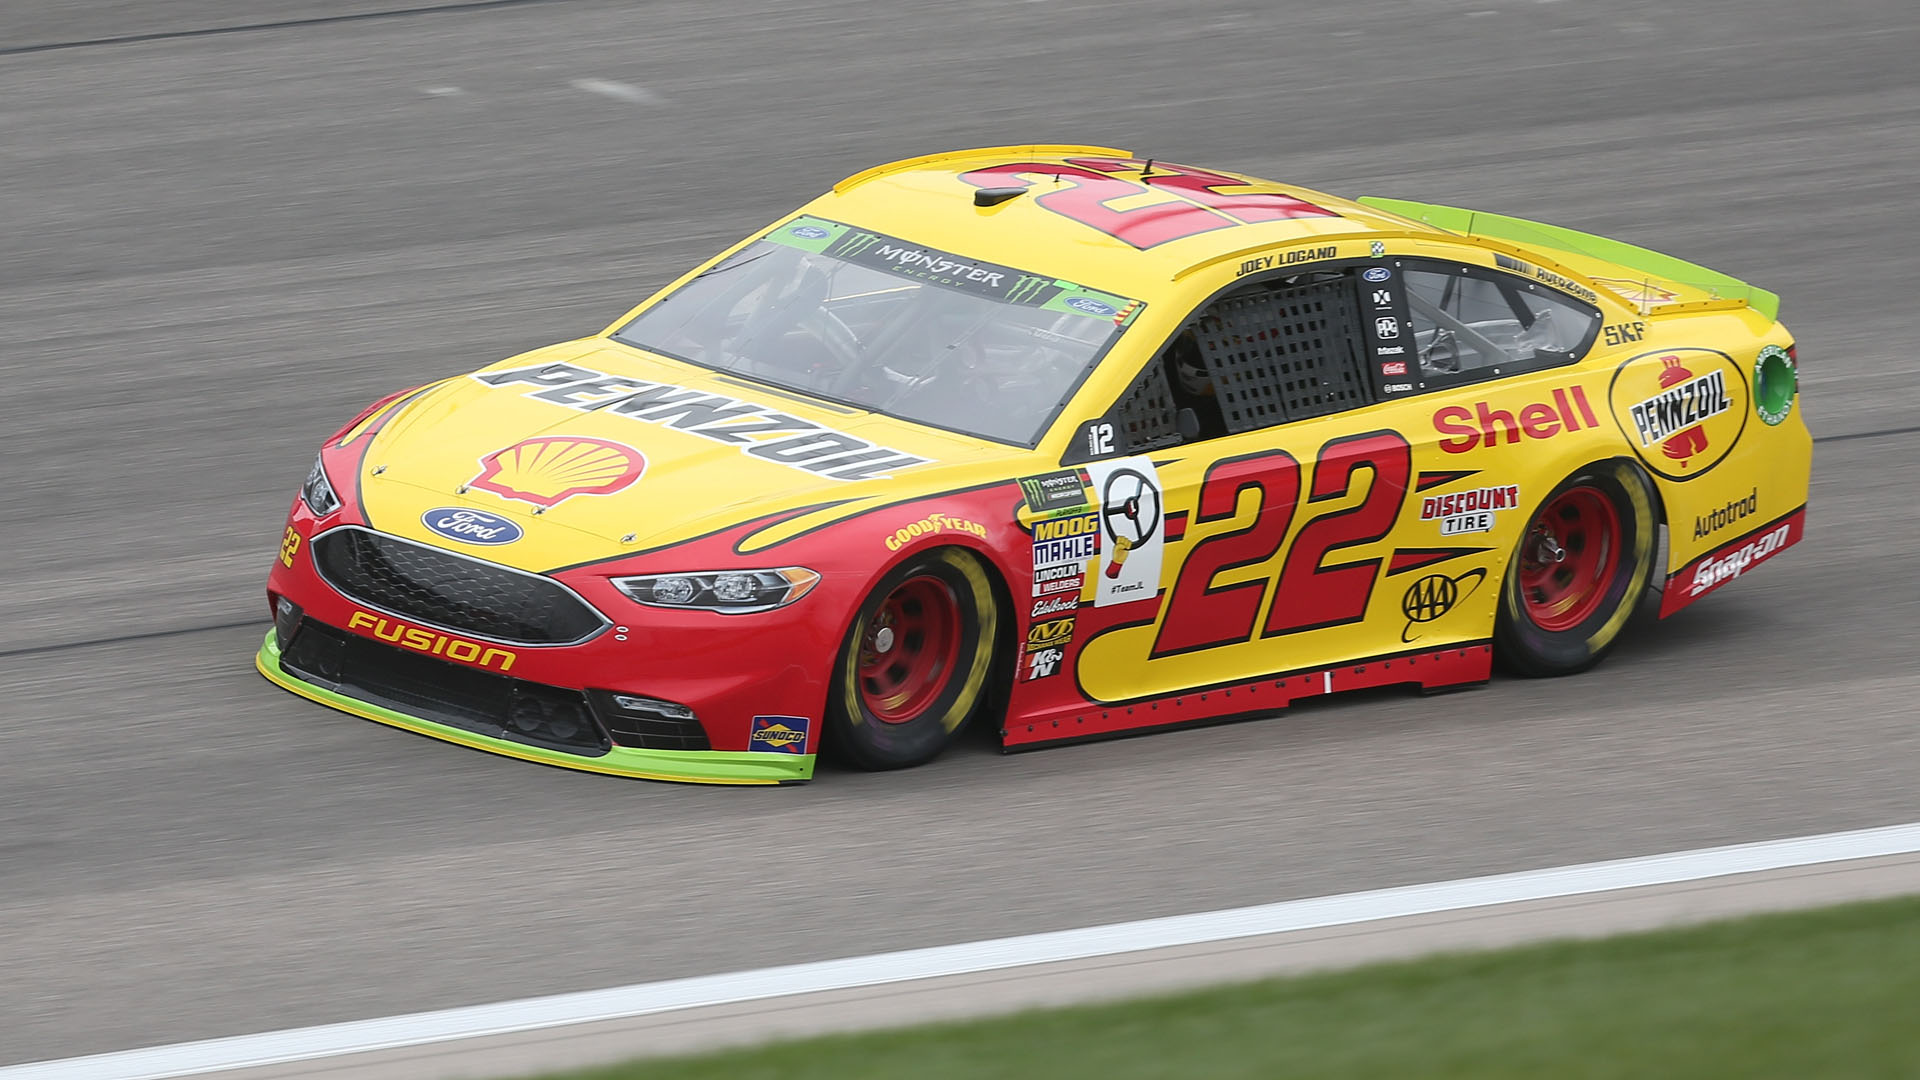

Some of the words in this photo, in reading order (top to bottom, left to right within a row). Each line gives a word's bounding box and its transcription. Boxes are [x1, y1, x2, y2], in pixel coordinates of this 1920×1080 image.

[892, 266, 964, 286] ENERGY
[1236, 256, 1273, 277] JOEY
[1279, 246, 1337, 265] LOGANO
[1073, 299, 1109, 314] Ford
[1604, 321, 1645, 346] SKF
[472, 363, 932, 480] PENNZOIL
[1433, 385, 1599, 454] Shell
[1630, 369, 1730, 447] PENNZOIL
[1090, 423, 1115, 455] 12
[1421, 486, 1518, 520] DISCOUNT
[437, 511, 505, 542] Ford
[885, 513, 987, 551] GOODYEAR
[1035, 514, 1098, 542] MOOG
[1445, 514, 1488, 532] TIRE
[280, 526, 301, 568] 22
[1034, 536, 1093, 565] MAHLE
[1148, 429, 1411, 660] 22
[1035, 565, 1078, 583] LINCOLN
[1043, 578, 1080, 593] WELDERS
[1031, 596, 1079, 617] Edelbrock
[347, 611, 517, 671] FUSION
[754, 730, 803, 742] SUNOCO
